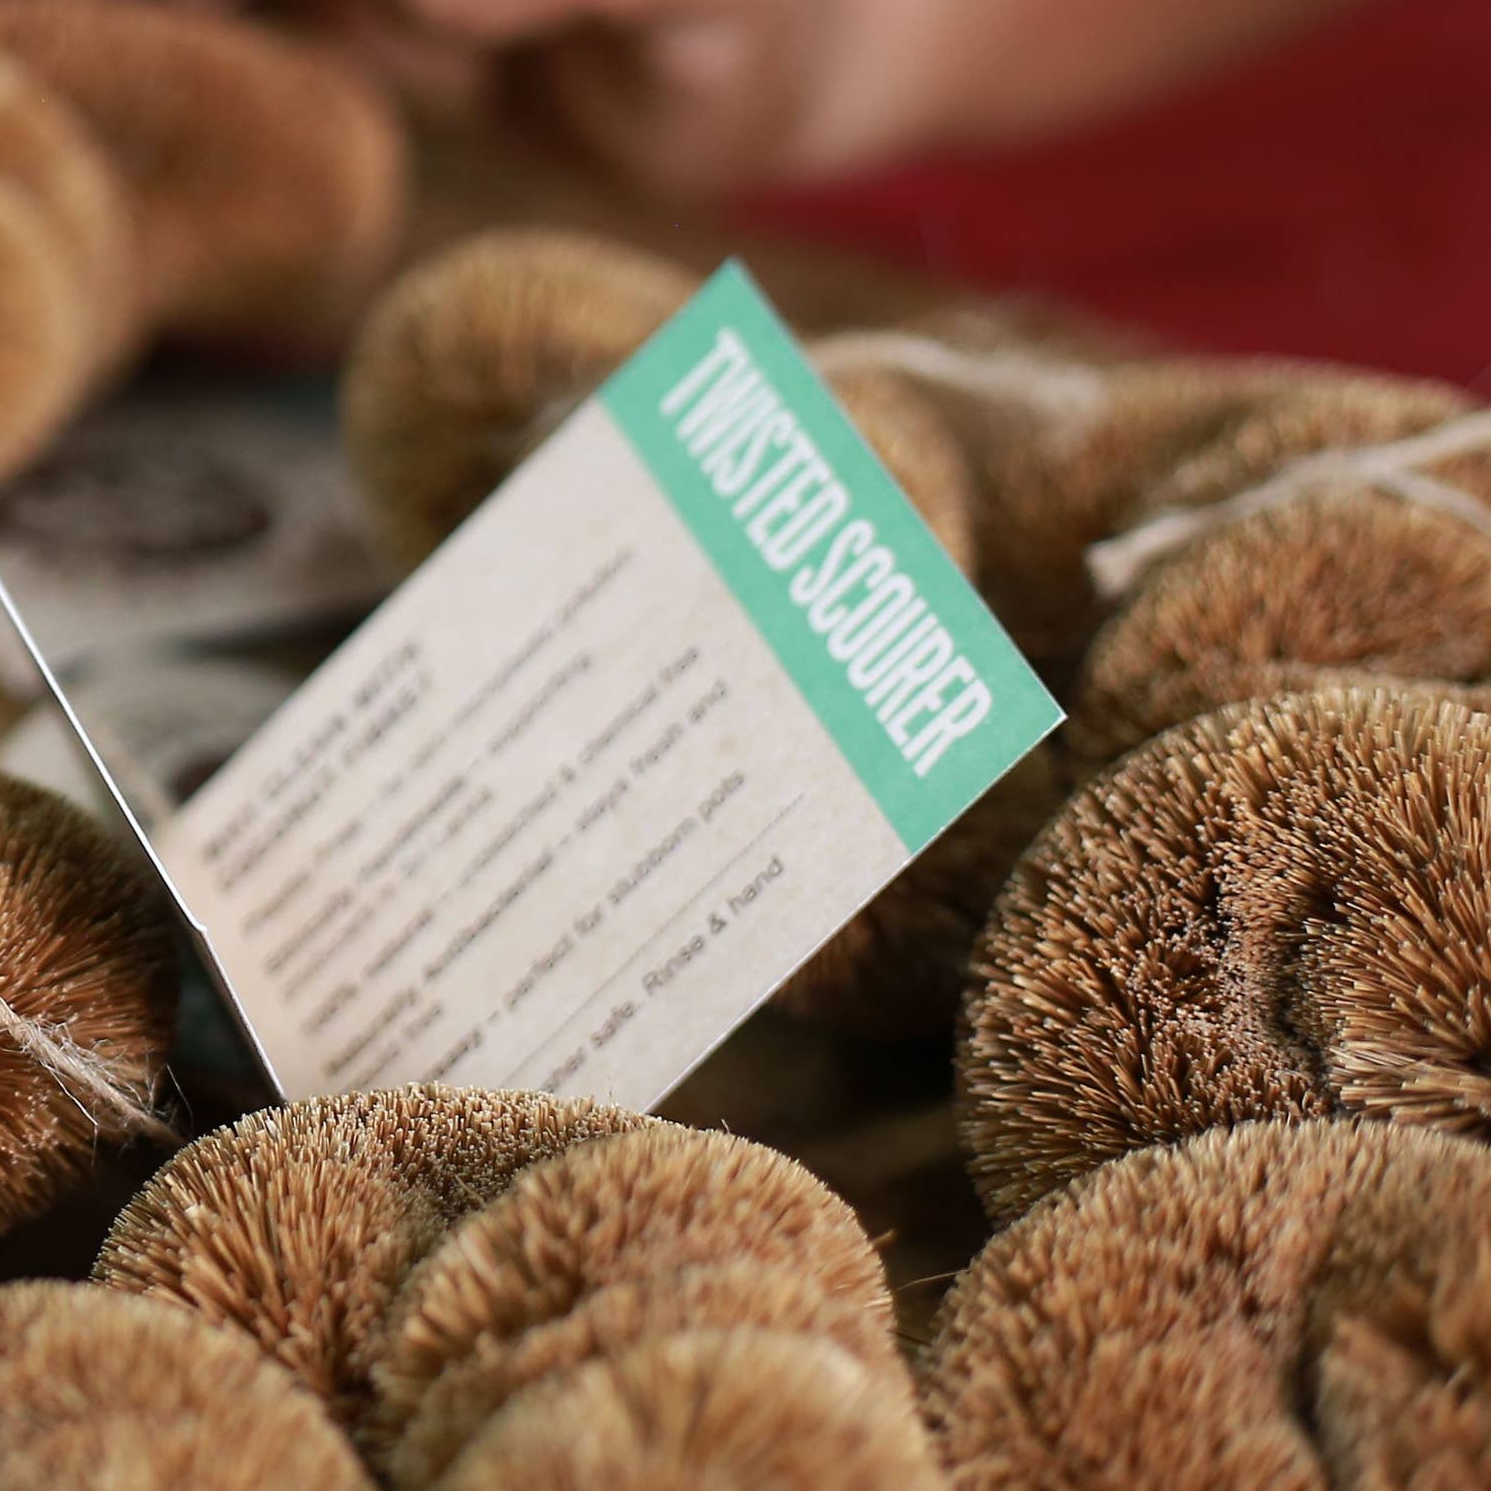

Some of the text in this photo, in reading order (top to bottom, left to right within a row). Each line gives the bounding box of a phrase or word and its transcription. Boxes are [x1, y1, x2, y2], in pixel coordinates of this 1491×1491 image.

[656, 327, 998, 778] TWISTED SCOURER
[497, 929, 575, 1011] perfect
[570, 899, 607, 937] for
[694, 767, 748, 825] pots
[640, 930, 708, 996] Rinse
[702, 910, 727, 935] &
[724, 854, 786, 917] hand
